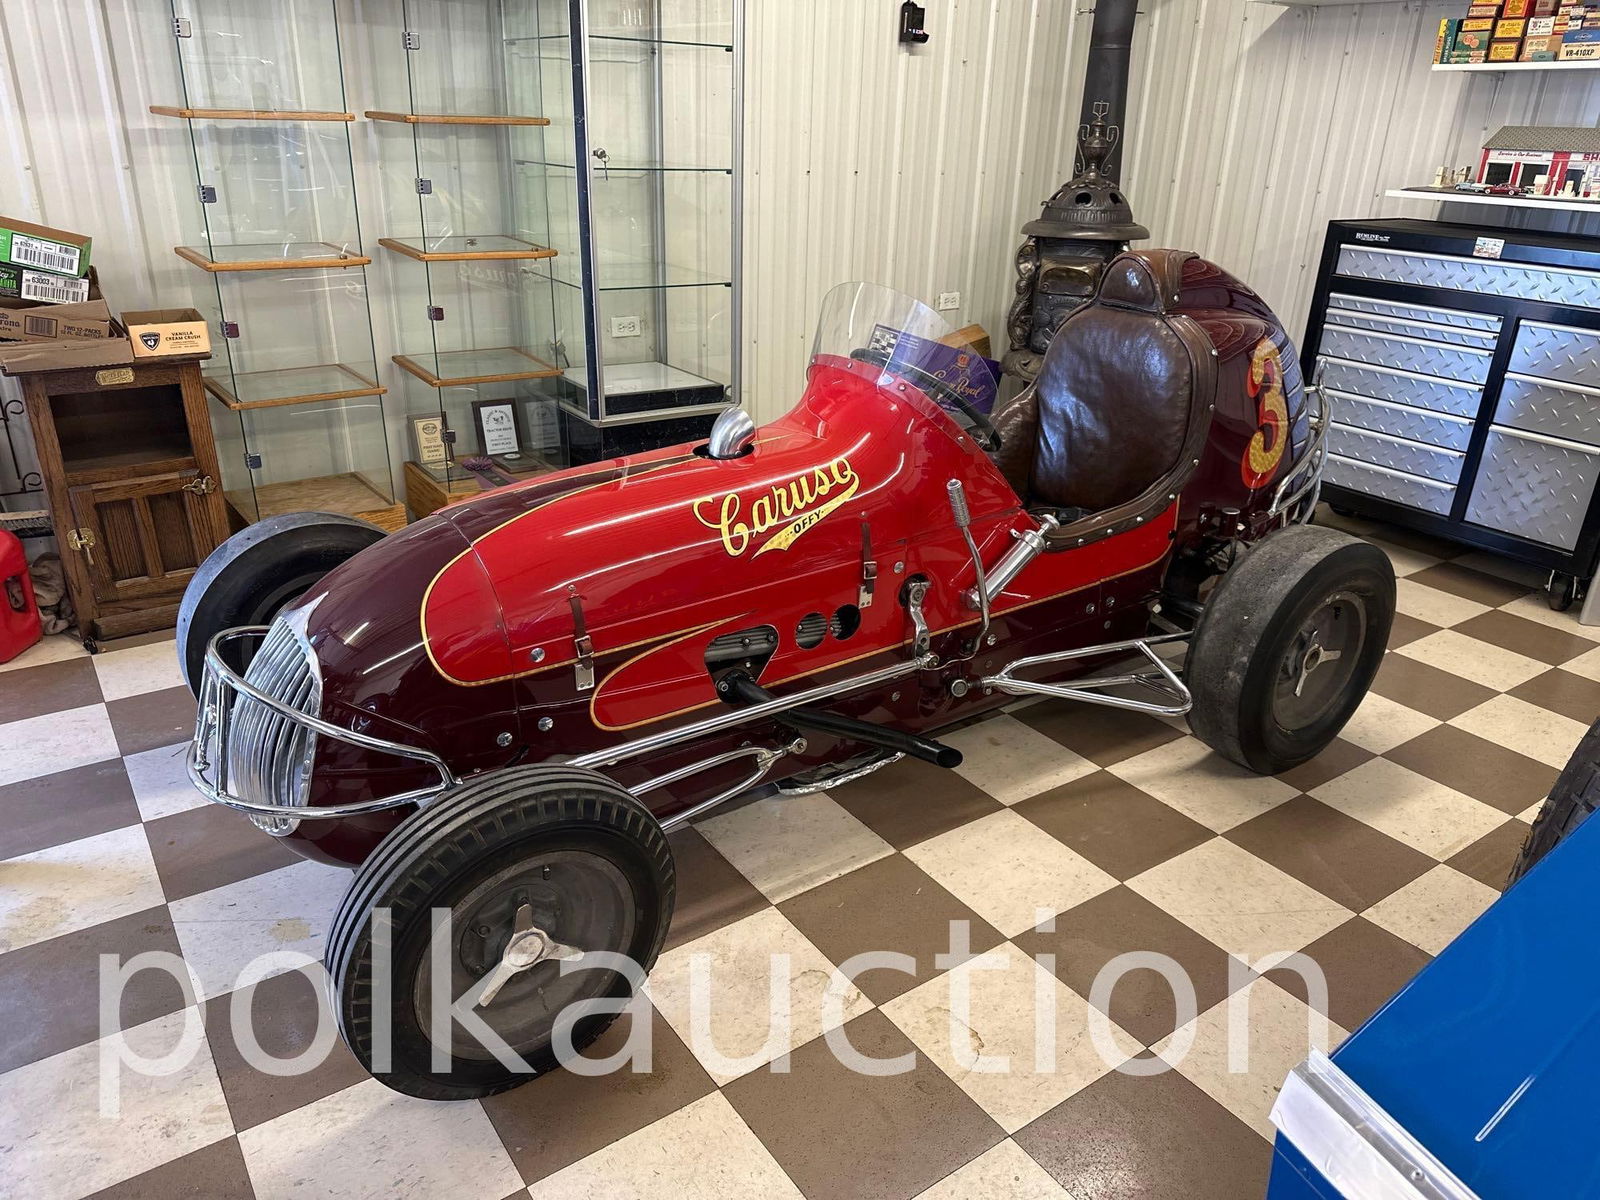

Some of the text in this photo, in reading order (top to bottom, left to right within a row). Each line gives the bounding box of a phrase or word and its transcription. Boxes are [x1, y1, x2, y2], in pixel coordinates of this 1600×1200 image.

[1565, 48, 1595, 57] VR-410XP
[957, 377, 986, 398] Royal
[1245, 336, 1289, 482] 3
[692, 457, 853, 557] Caruso
[792, 509, 823, 534] OFFY
